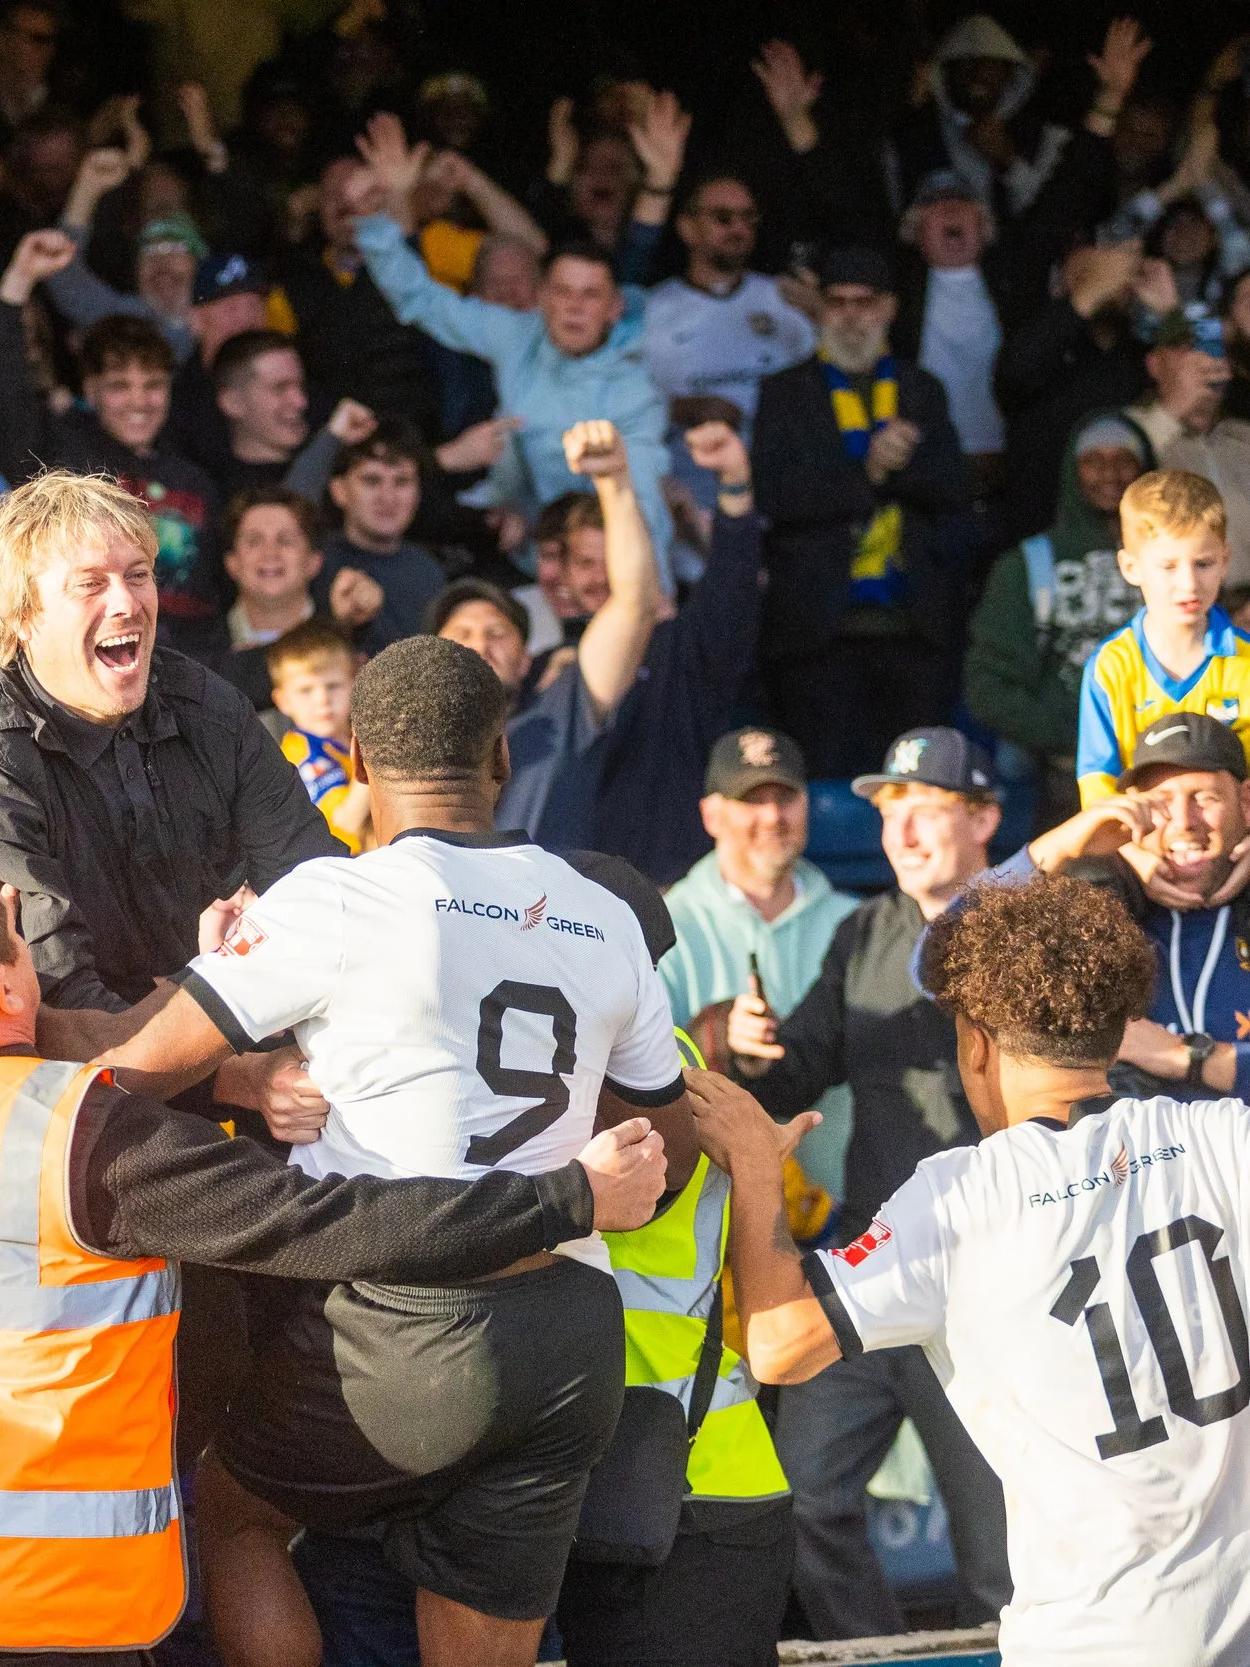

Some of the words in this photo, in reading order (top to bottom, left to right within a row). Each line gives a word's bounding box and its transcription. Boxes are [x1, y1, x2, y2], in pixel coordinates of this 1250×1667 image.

[434, 898, 519, 922] FALCON
[546, 916, 606, 943] GREEN
[463, 979, 578, 1167] 9
[1028, 1171, 1111, 1208] FALCON
[1129, 1143, 1187, 1175] GREEN
[1049, 1214, 1250, 1461] 10
